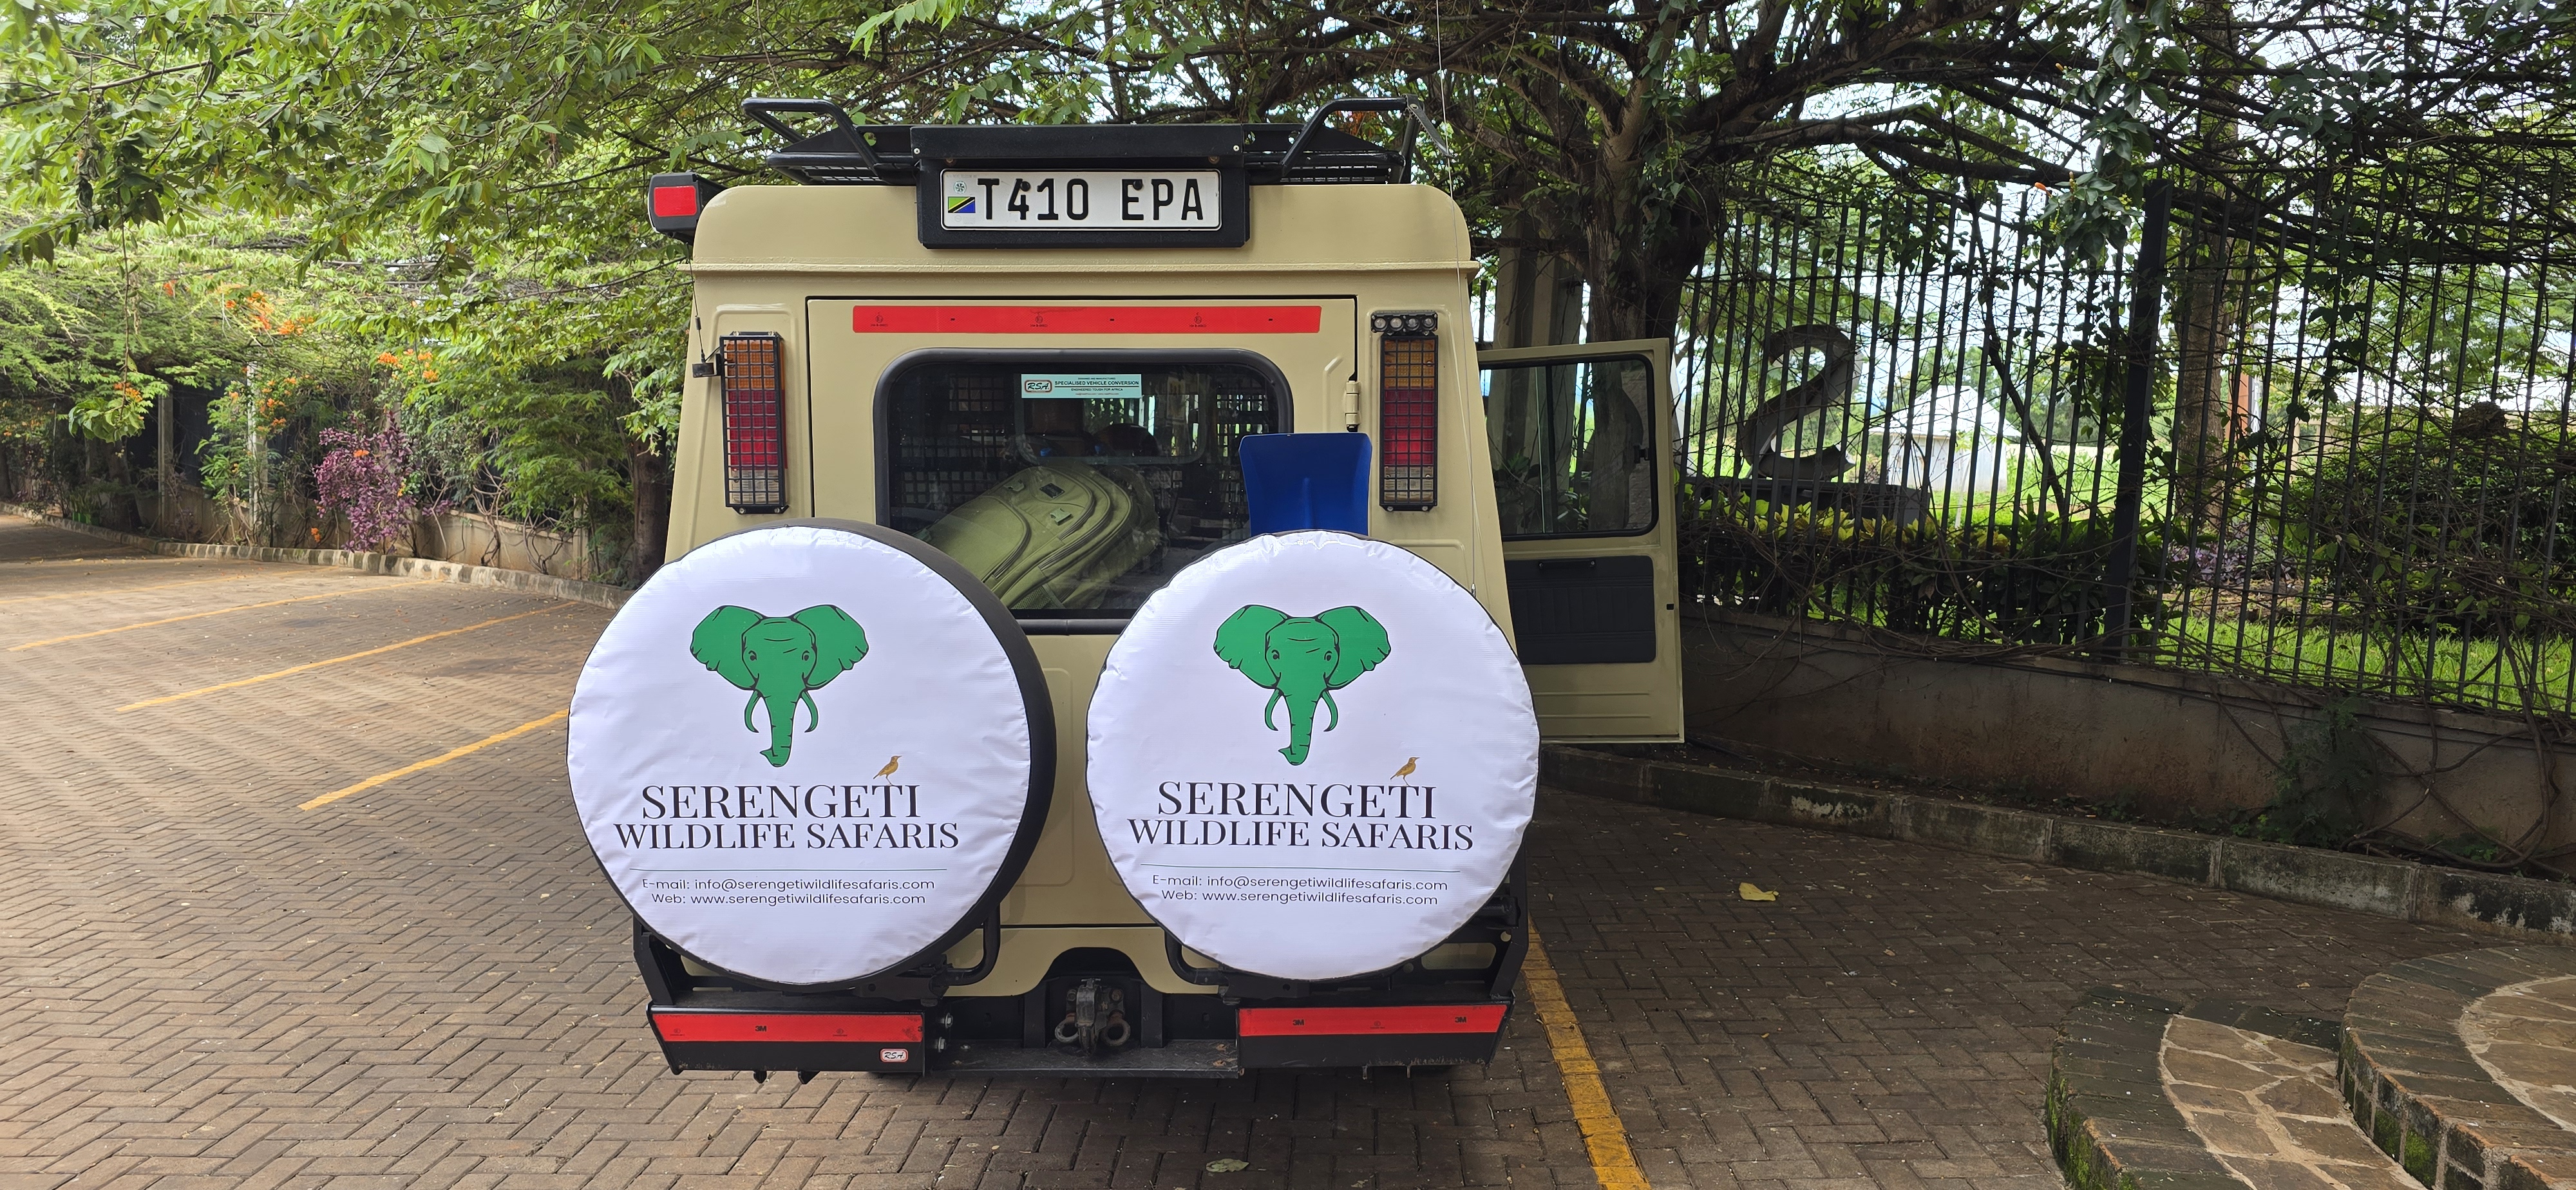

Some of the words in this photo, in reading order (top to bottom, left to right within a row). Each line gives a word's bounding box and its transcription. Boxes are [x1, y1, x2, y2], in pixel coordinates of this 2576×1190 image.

[977, 178, 1088, 220] T410
[1122, 179, 1203, 220] EPA
[642, 784, 921, 818] SERENGETI
[1158, 781, 1437, 818] SERENGETI
[613, 823, 795, 849] WILDLIFE
[808, 822, 959, 849] SAFARIS
[1127, 818, 1309, 846] WILDLIFE
[1322, 822, 1473, 850] SAFARIS
[643, 878, 690, 889] E-mail:
[694, 878, 934, 892] info@serengetiwildlifesafaris.com
[1153, 874, 1202, 886] E-mail:
[1208, 876, 1448, 891] info@serengetiwildlifesafaris.com
[652, 893, 686, 903] Web:
[690, 893, 925, 907] www.serengetiwildlifesafaris.com
[1161, 889, 1197, 900] Web:
[1202, 891, 1438, 905] www.serengetiwildlifesafaris.com
